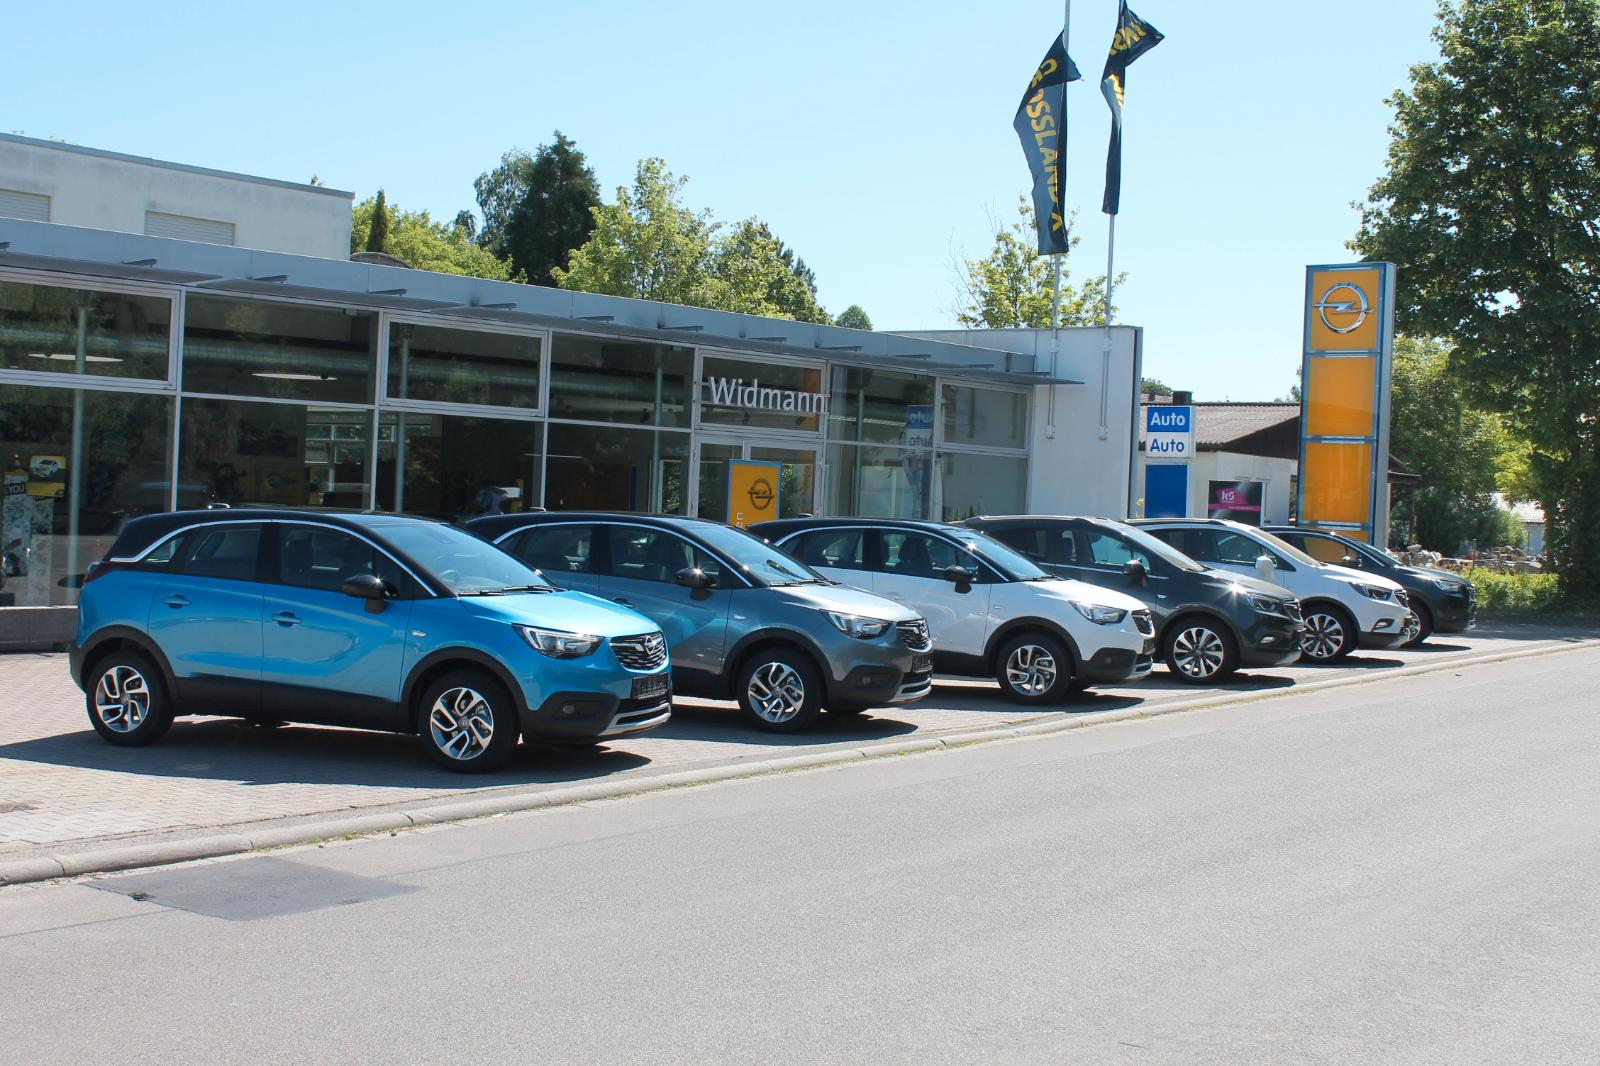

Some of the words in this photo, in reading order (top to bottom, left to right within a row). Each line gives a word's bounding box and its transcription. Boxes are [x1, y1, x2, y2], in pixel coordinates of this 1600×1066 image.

[708, 376, 825, 415] Widmann
[1150, 411, 1186, 426] Auto
[1150, 438, 1185, 453] Auto
